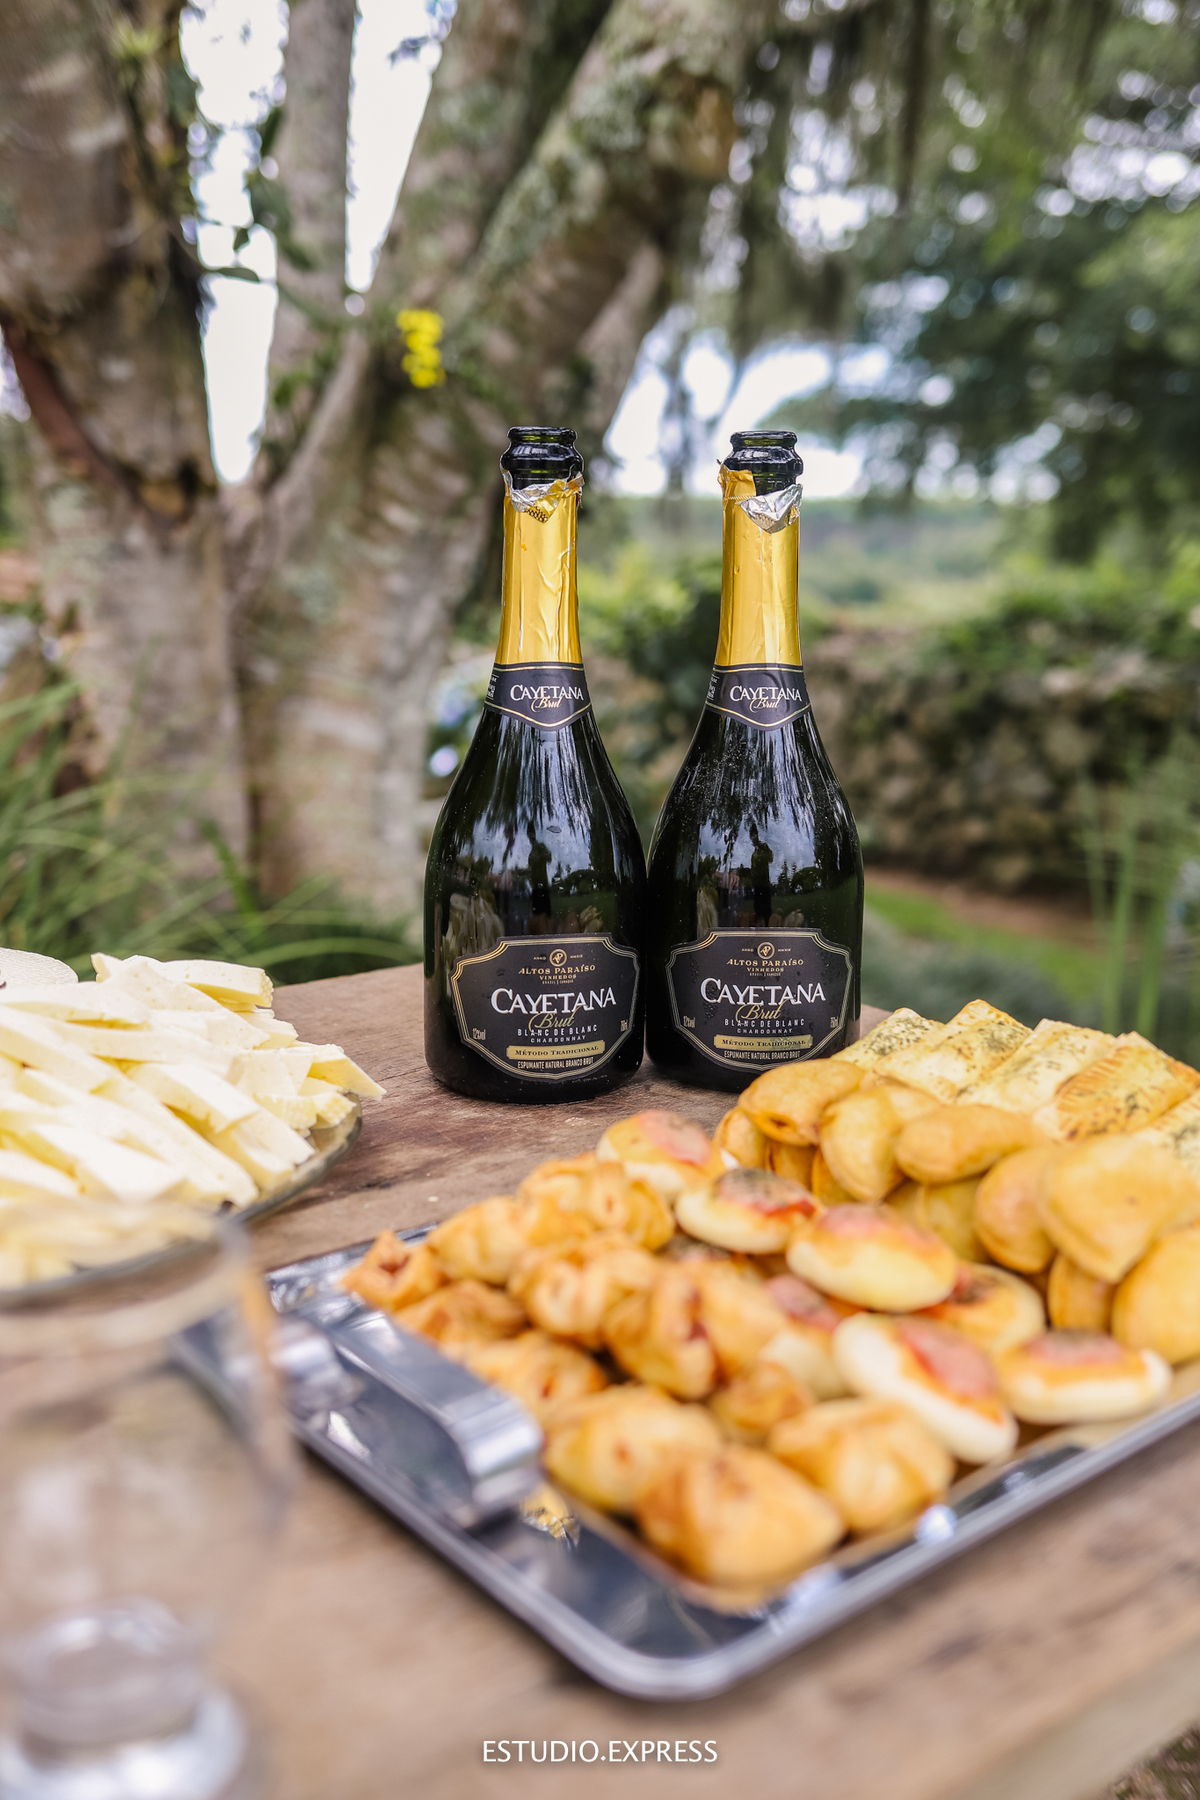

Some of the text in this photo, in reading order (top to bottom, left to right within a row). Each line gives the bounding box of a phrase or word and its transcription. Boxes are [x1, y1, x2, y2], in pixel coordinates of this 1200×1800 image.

[510, 684, 584, 701] CAYETANA
[729, 685, 802, 702] CAYETANA
[531, 697, 562, 712] Brut
[749, 697, 781, 713] Brut
[518, 964, 596, 975] ALTOS PARAÍSO
[726, 958, 804, 967] ALTOS PARAÍSO
[700, 977, 826, 1006] CAYETANA
[490, 987, 617, 1015] CAYETANA
[735, 1000, 785, 1025] Brut
[528, 1009, 577, 1034] Brut
[724, 1018, 805, 1028] BLANC DE BLANC
[517, 1024, 598, 1037] BLANC DE BLANC
[530, 1035, 586, 1043] CHARDONNAY
[722, 1038, 806, 1048] MÉTODO TRADICIONAL
[515, 1045, 599, 1056] MÉTODO TRADICIONAL
[724, 1050, 801, 1060] ESPUMANTE NATURAL BRANCO BRUT
[517, 1056, 594, 1070] ESPUMANTE NATURAL BRANCO BRUT
